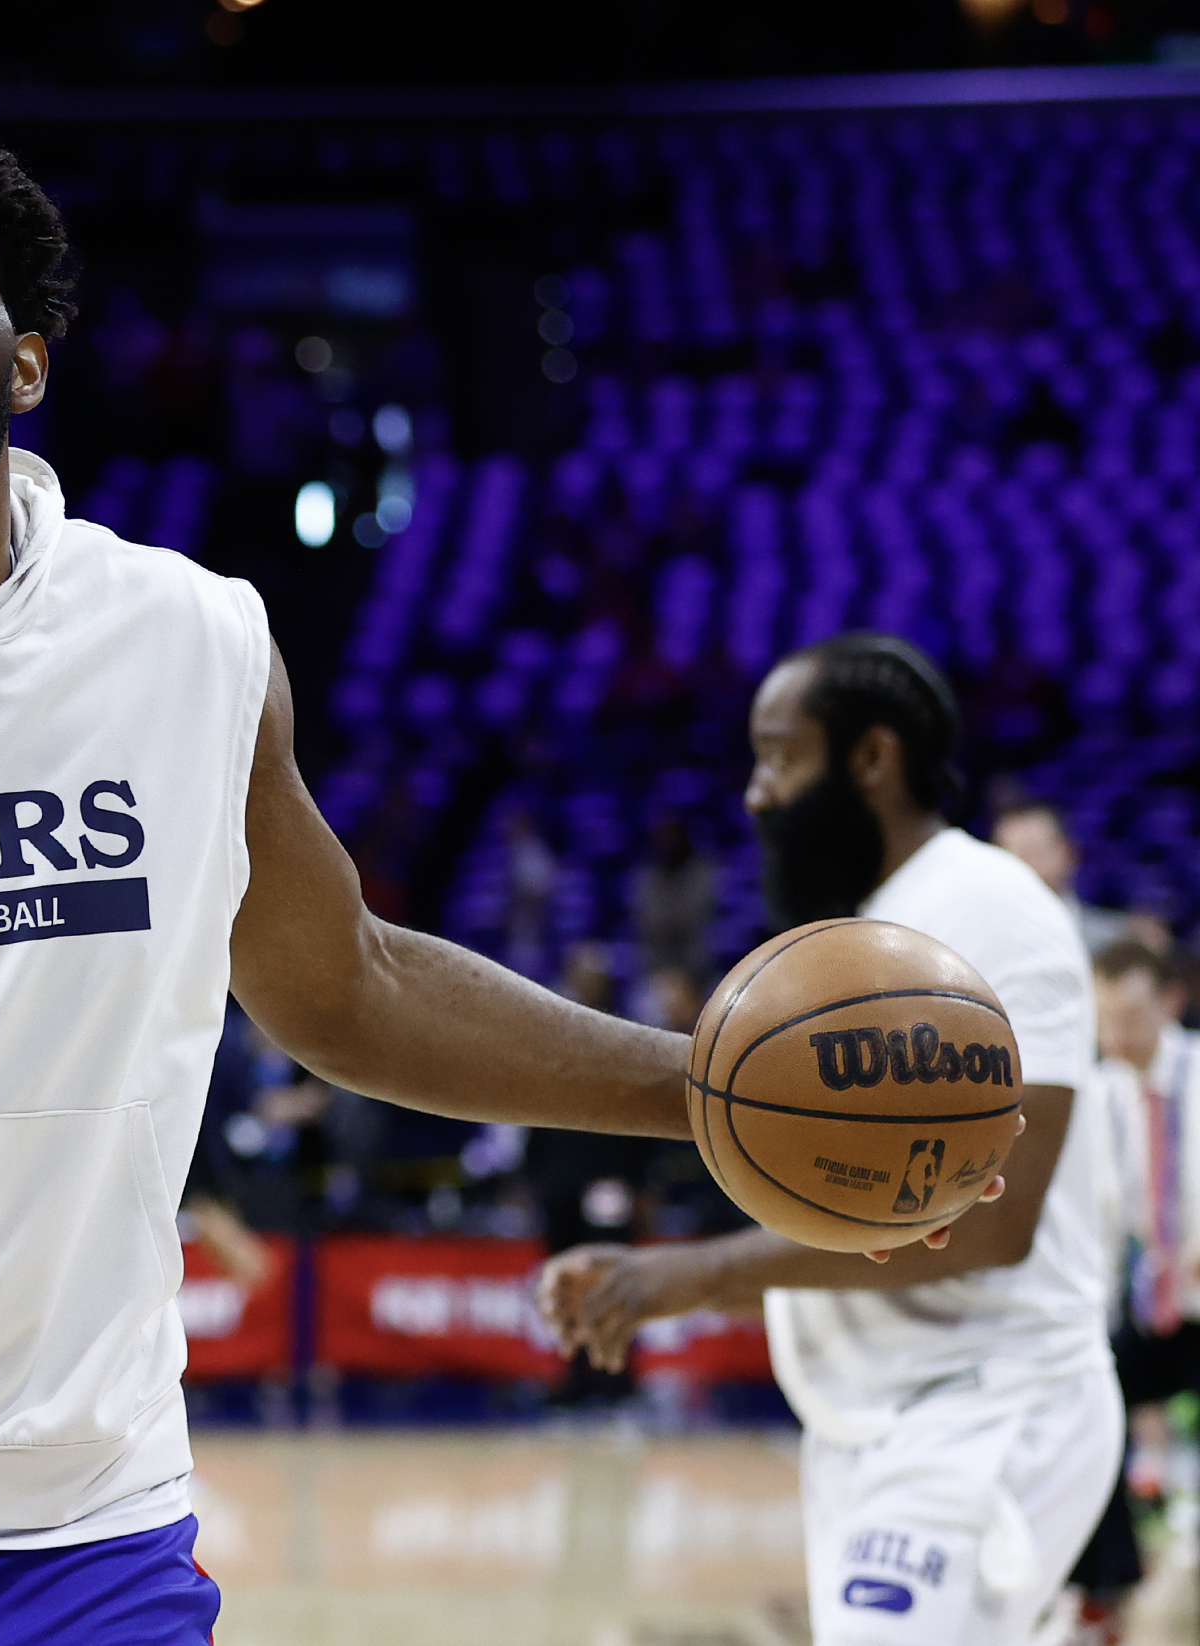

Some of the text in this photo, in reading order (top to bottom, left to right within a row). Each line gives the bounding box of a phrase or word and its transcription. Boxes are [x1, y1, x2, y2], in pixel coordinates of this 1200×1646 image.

[810, 1022, 1013, 1091] Wilson
[814, 1156, 891, 1183] OFFICIAL GAME BALL
